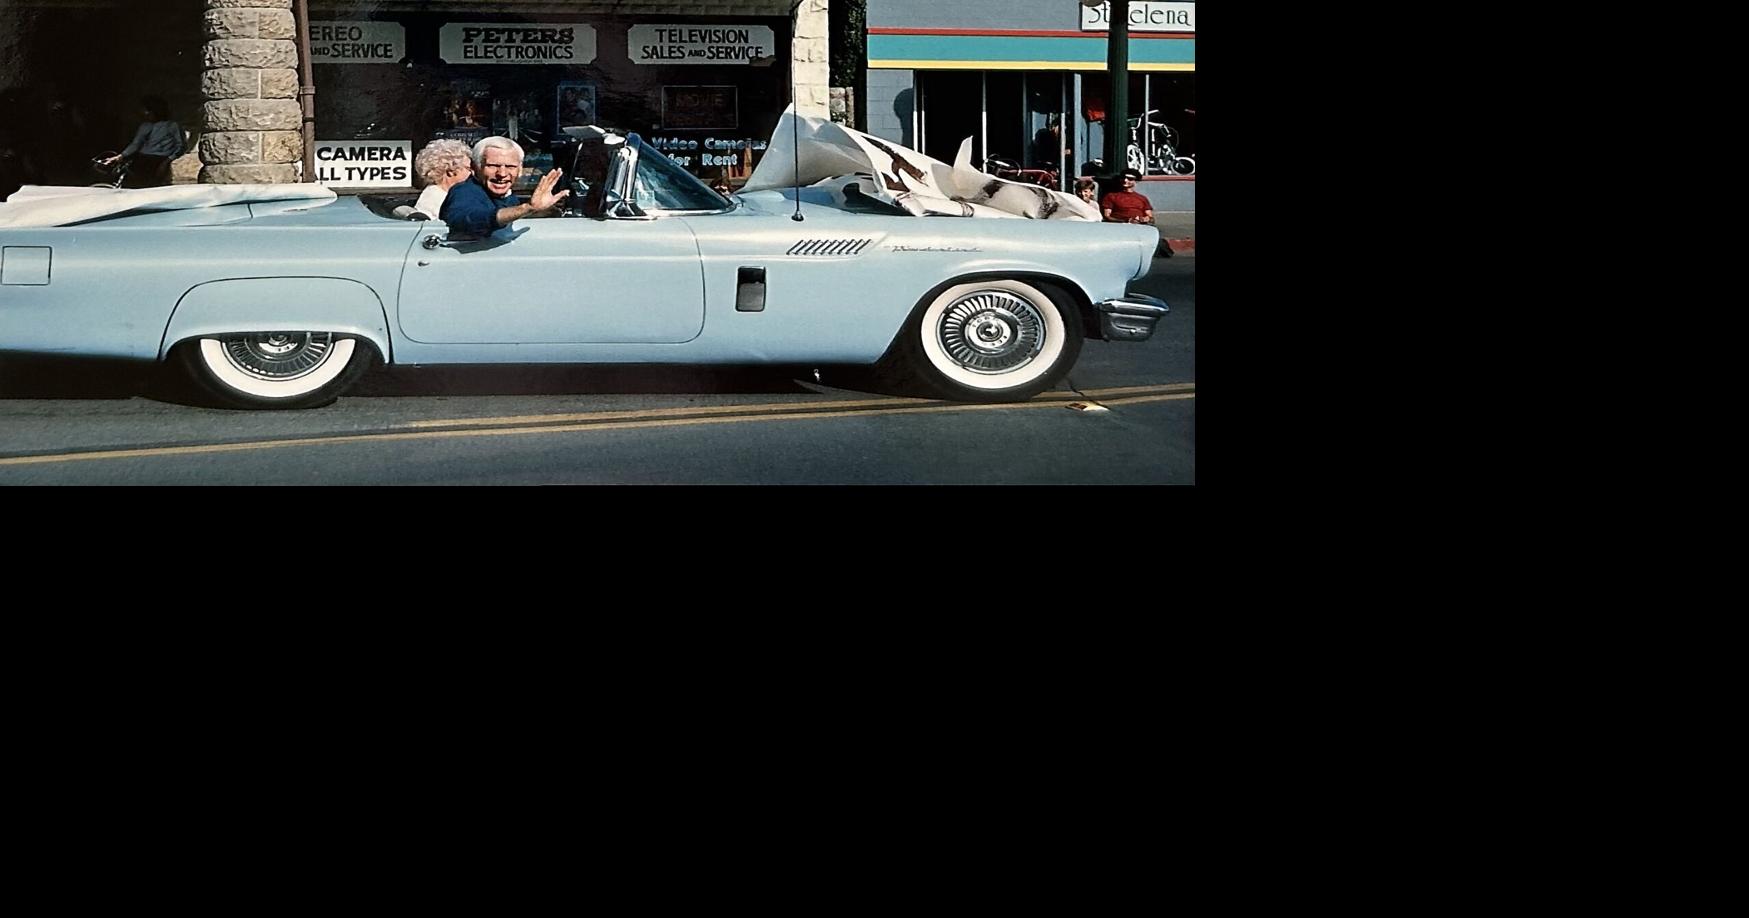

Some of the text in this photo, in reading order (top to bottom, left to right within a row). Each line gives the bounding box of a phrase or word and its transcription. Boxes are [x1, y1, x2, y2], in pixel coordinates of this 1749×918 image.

[1128, 4, 1192, 26] elena
[462, 27, 575, 44] PETERS
[655, 29, 749, 43] TELEVISION
[330, 43, 393, 58] SERVICE
[463, 45, 573, 59] ELECTRONICS
[641, 46, 685, 59] SALES
[706, 46, 763, 60] SERVICE
[652, 137, 698, 150] Video
[316, 146, 407, 161] CAMERA
[701, 153, 738, 166] Rent
[315, 166, 407, 181] LL TYPES
